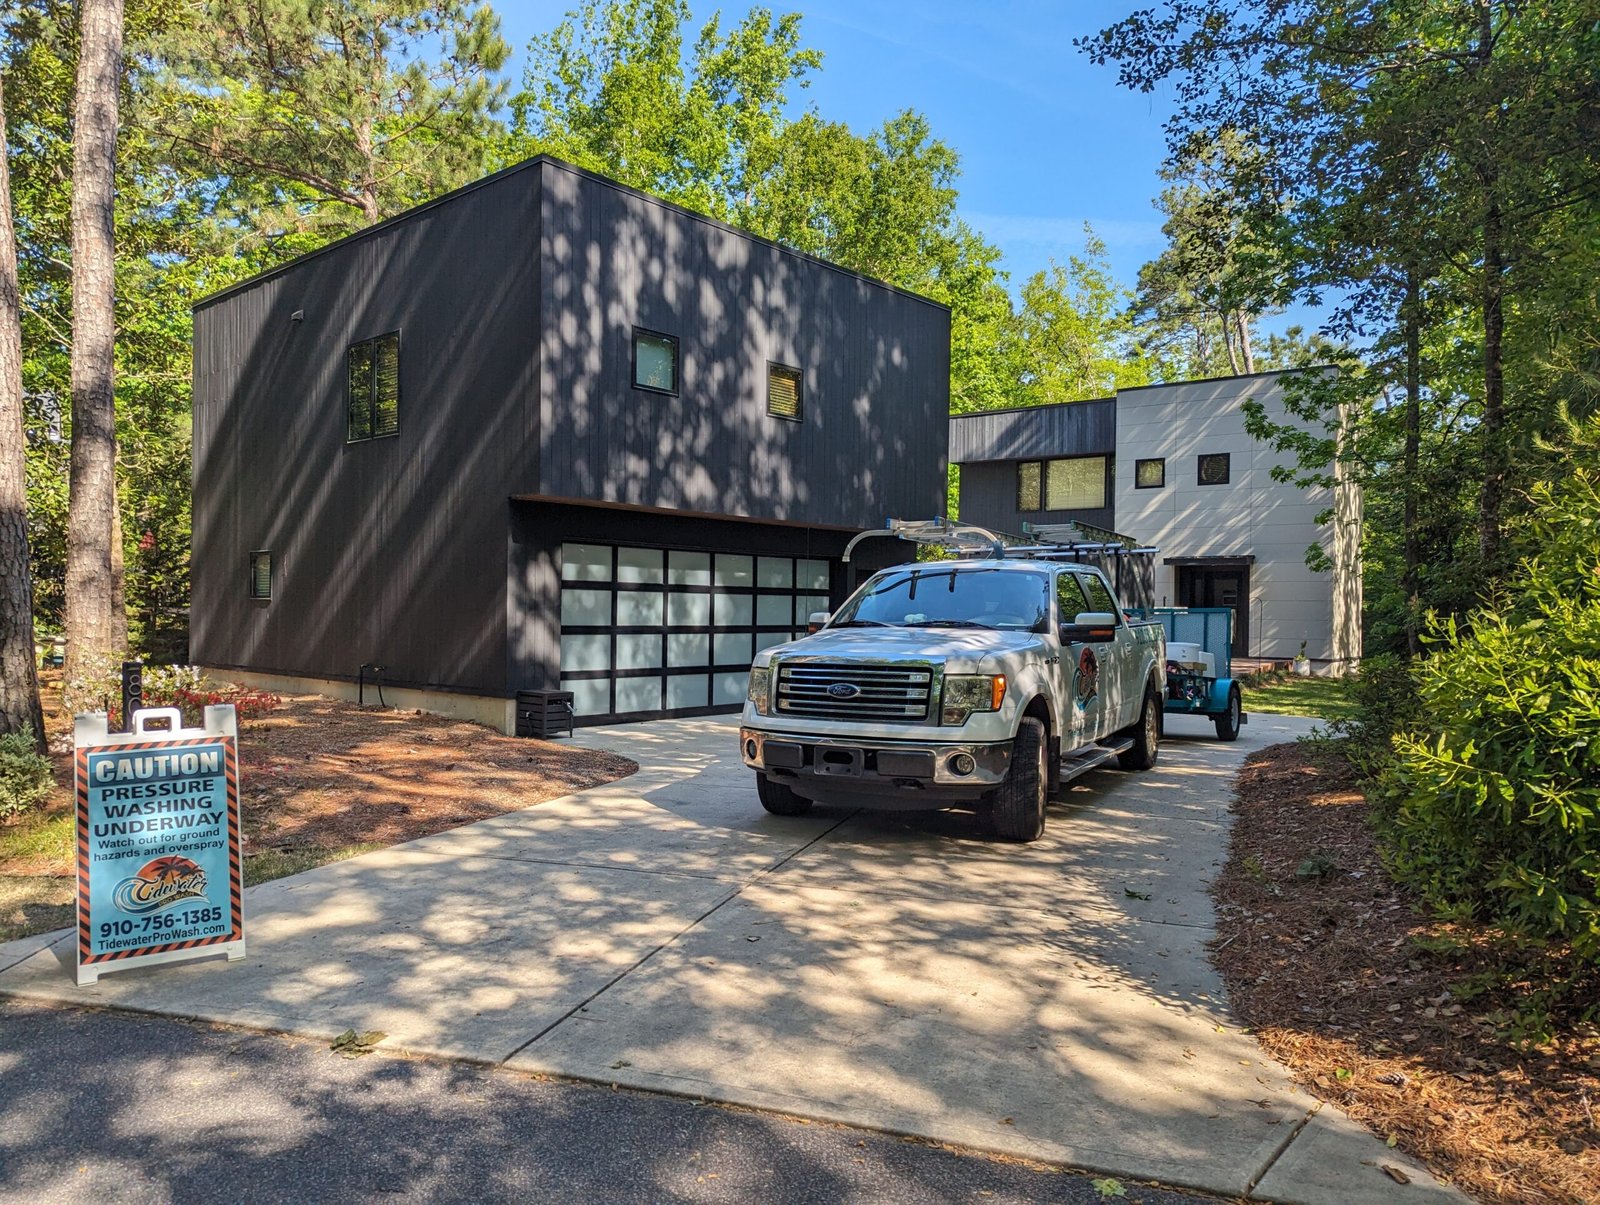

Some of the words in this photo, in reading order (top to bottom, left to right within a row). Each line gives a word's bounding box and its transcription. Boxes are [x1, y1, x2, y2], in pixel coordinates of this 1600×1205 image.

[831, 685, 854, 696] Ford
[95, 751, 219, 783] CAUTION
[102, 779, 215, 801] PRESSURE
[103, 796, 213, 818] WASHING
[94, 811, 223, 837] UNDERWAY
[98, 837, 135, 849] Watch
[138, 834, 157, 845] out
[160, 833, 177, 842] for
[180, 827, 220, 842] ground
[94, 849, 140, 862] hazards
[144, 844, 165, 856] and
[169, 840, 225, 851] overspray
[135, 873, 208, 901] Tidewater
[100, 906, 222, 938] 910-756-1385
[98, 924, 226, 951] TidewaterProWash.com
